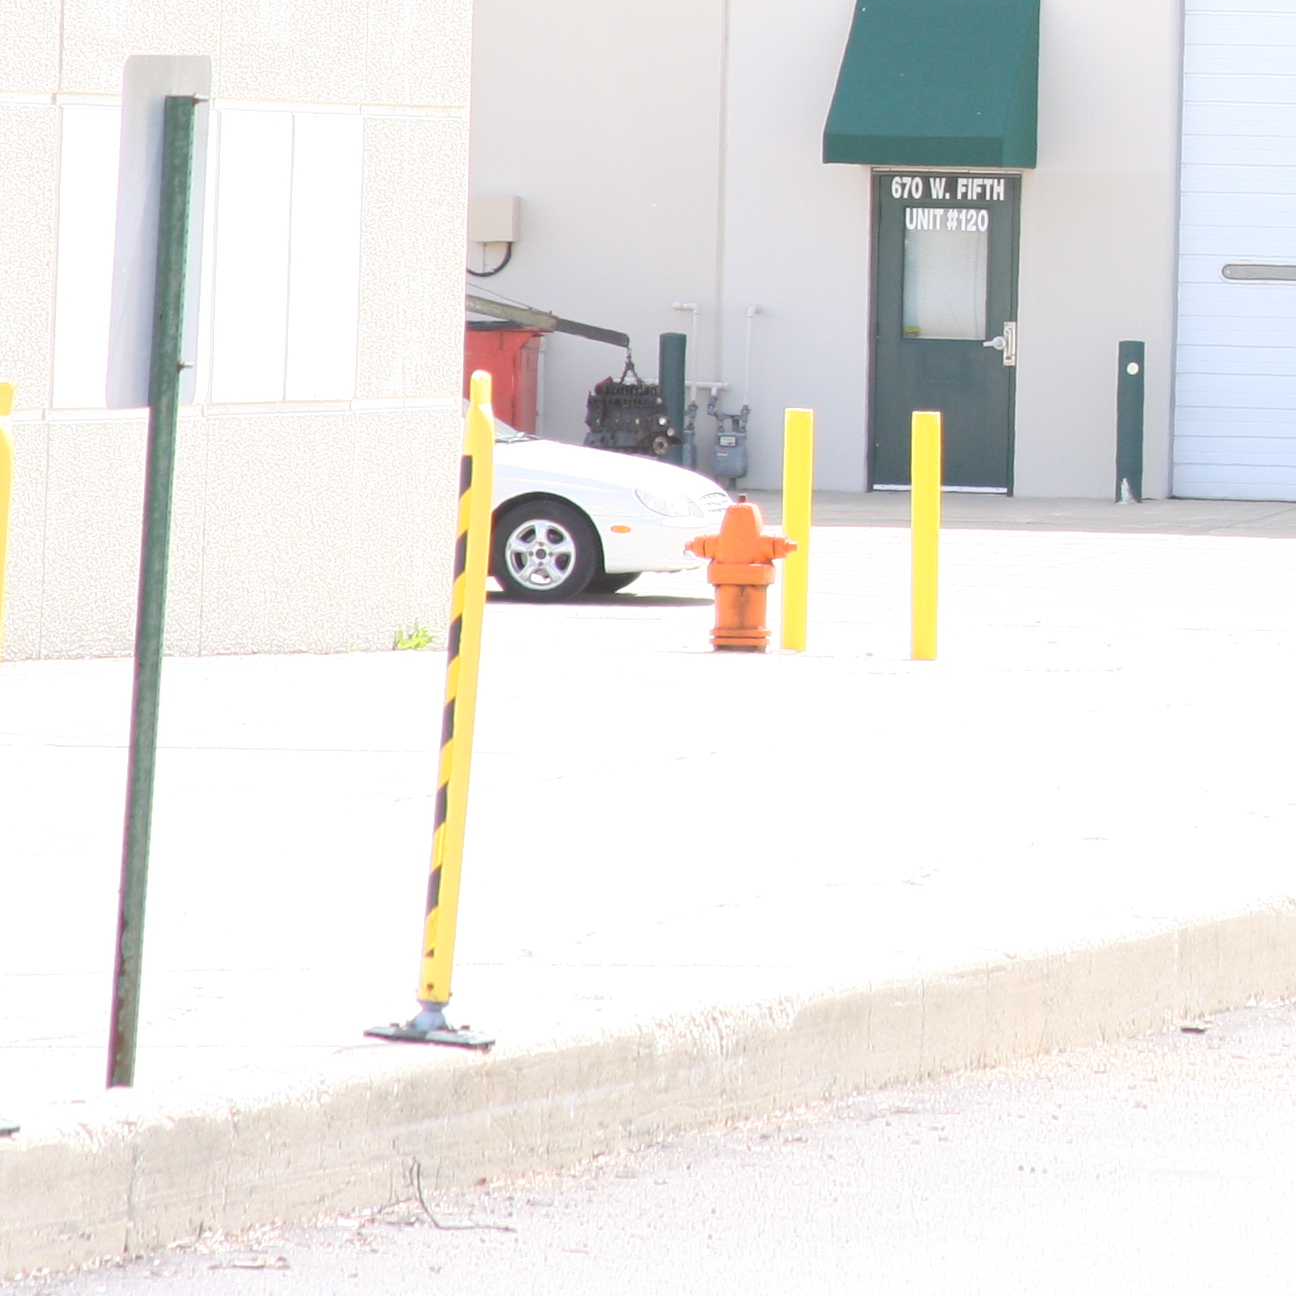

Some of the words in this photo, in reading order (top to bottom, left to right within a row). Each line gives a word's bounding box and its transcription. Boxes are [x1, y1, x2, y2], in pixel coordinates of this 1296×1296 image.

[891, 176, 923, 199] 670
[930, 177, 950, 200] W.
[956, 178, 1005, 201] FIFTH
[905, 207, 944, 230] UNIT
[946, 209, 989, 232] #120
